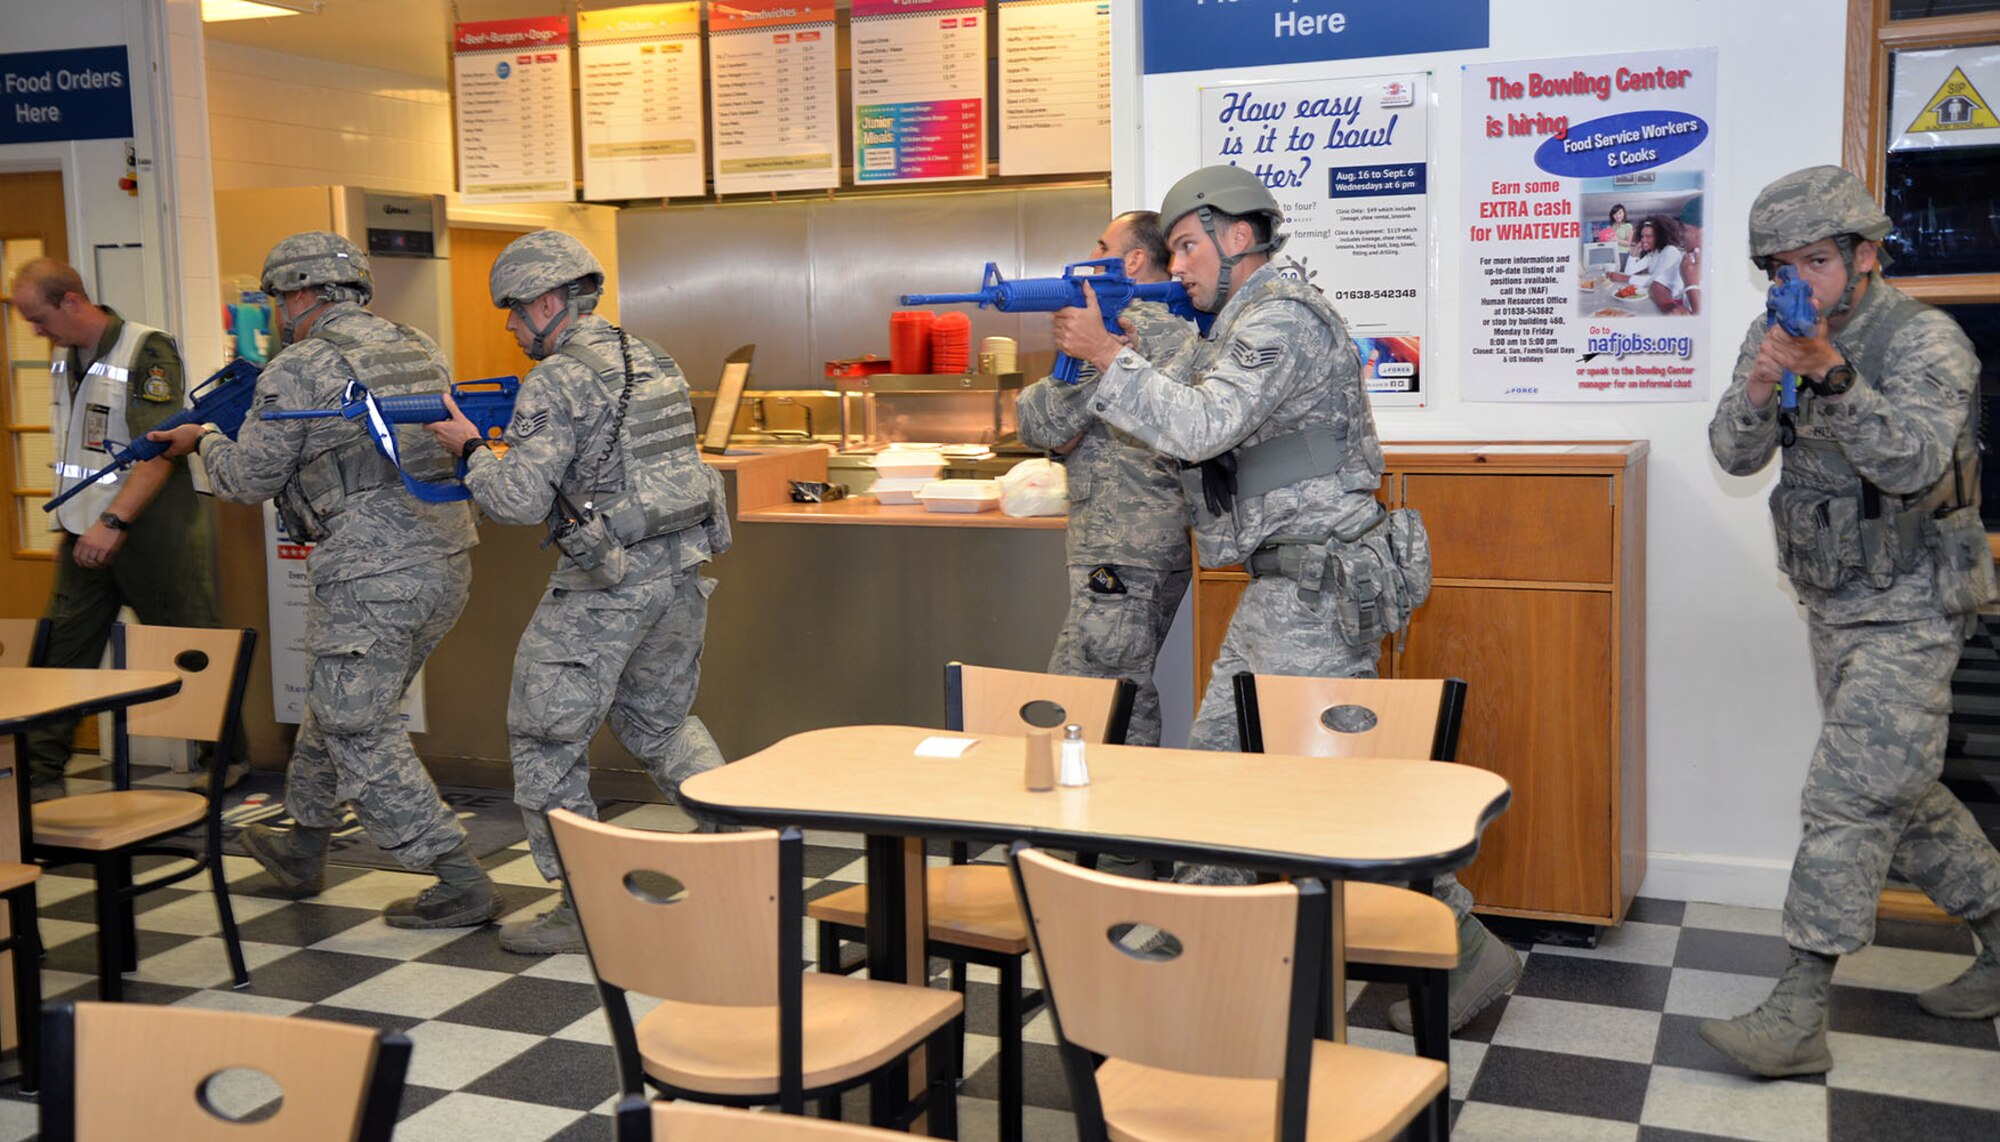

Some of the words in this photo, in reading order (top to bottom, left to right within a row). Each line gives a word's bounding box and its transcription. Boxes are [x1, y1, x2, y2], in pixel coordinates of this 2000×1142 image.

[742, 8, 797, 21] Sandwiches
[1275, 11, 1347, 37] Here
[5, 71, 52, 93] Food
[57, 69, 123, 90] Orders
[1487, 76, 1523, 100] The
[1528, 71, 1610, 101] Bowling
[1615, 67, 1692, 92] Center
[1947, 82, 1966, 95] SIP
[15, 103, 61, 123] Here
[1219, 91, 1287, 124] How
[1293, 96, 1363, 126] easy
[862, 115, 894, 129] Junior
[1486, 115, 1503, 138] is
[1507, 112, 1568, 140] hiring
[863, 130, 894, 145] Meals
[1219, 126, 1243, 157] is
[1253, 124, 1278, 154] it
[1285, 126, 1316, 152] to
[1323, 113, 1399, 149] bowl
[1563, 135, 1592, 153] Food
[1594, 129, 1640, 148] Service
[1641, 120, 1698, 139] Workers
[1607, 153, 1617, 167] &
[1620, 148, 1656, 165] Cooks
[1229, 156, 1311, 189] tter?
[1336, 171, 1356, 182] Aug.
[1359, 170, 1369, 179] 16
[1371, 170, 1381, 178] to
[1383, 169, 1406, 180] Sept.
[1408, 168, 1414, 177] 6
[1335, 181, 1383, 191] Wednesdays
[1384, 181, 1393, 189] at
[1394, 180, 1400, 188] 6
[1402, 181, 1415, 190] pm
[1492, 181, 1520, 195] Earn
[1524, 180, 1560, 194] some
[1283, 203, 1292, 211] to
[1294, 201, 1317, 211] four?
[1480, 200, 1529, 219] EXTRA
[1533, 198, 1572, 217] cash
[1294, 229, 1331, 239] forming!
[1470, 225, 1492, 242] for
[1496, 221, 1580, 241] WHATEVER
[1480, 257, 1491, 265] For
[1493, 257, 1511, 265] more
[1513, 255, 1554, 264] information
[1556, 255, 1570, 263] and
[1484, 266, 1520, 275] up-to-date
[1522, 266, 1544, 275] listing
[1546, 265, 1554, 273] of
[1555, 265, 1565, 273] all
[1490, 277, 1522, 286] positions
[1335, 289, 1417, 300] 01638-542348
[1500, 287, 1513, 295] call
[1515, 286, 1526, 295] the
[1528, 286, 1549, 295] (NAF)
[1481, 297, 1506, 306] Human
[1507, 296, 1545, 305] Resources
[1546, 296, 1568, 304] Office
[1492, 318, 1507, 326] stop
[1508, 318, 1517, 326] by
[1519, 317, 1547, 326] building
[1493, 328, 1521, 336] Monday
[1523, 327, 1530, 335] to
[1532, 327, 1554, 336] Friday
[1589, 326, 1600, 335] Go
[1602, 326, 1611, 335] to
[1489, 338, 1505, 346] 8:00
[1519, 338, 1527, 346] to
[1528, 337, 1545, 346] 5:00
[1546, 338, 1558, 346] pm
[1588, 332, 1690, 357] nafjobs.org
[1560, 346, 1575, 354] Days
[1518, 355, 1544, 363] holidays
[1576, 368, 1585, 376] or
[1587, 367, 1609, 377] speak
[1611, 366, 1619, 375] to
[1621, 366, 1634, 375] the
[1635, 365, 1666, 377] Bowling
[1667, 365, 1695, 375] Center
[1578, 381, 1611, 391] manager
[1613, 379, 1626, 389] for
[1628, 380, 1637, 388] an
[1639, 379, 1672, 388] informal
[1673, 379, 1692, 388] chat
